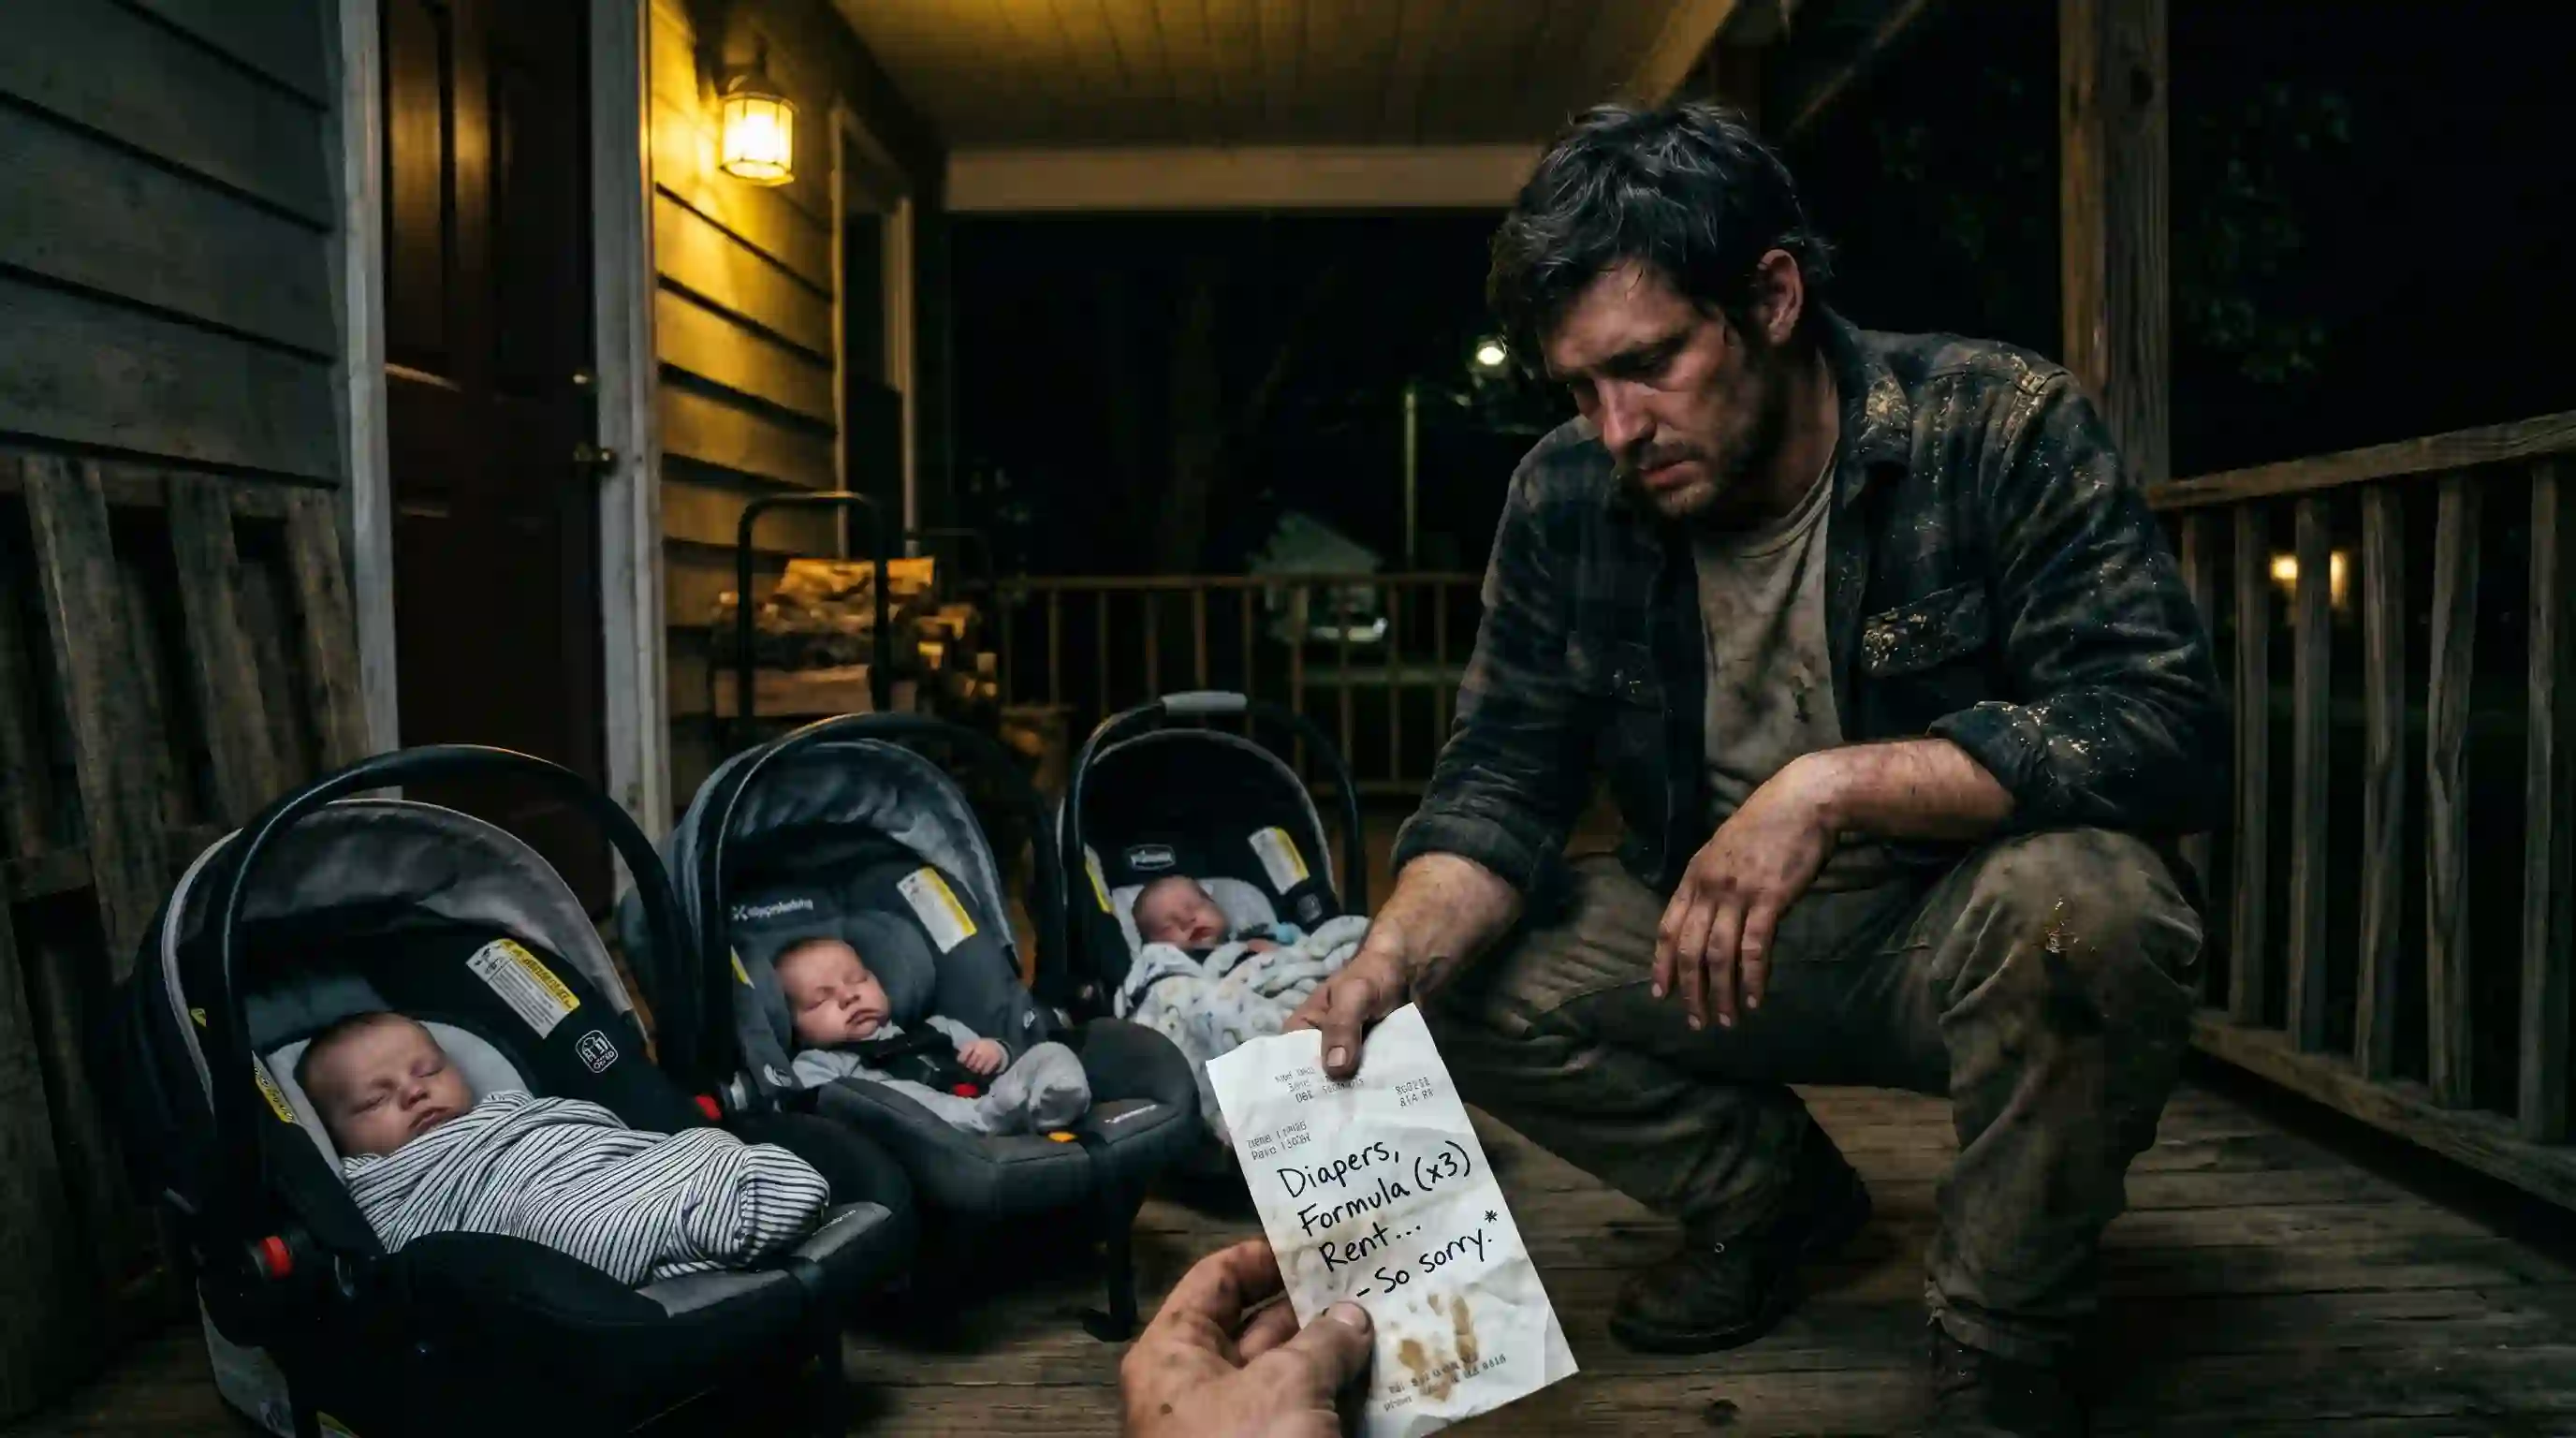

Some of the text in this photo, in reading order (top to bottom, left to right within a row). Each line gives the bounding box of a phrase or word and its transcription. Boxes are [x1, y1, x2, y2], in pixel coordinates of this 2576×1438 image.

[1277, 1141, 1399, 1198] Diapers,
[1297, 1140, 1471, 1238] Formula (x3)
[1318, 1225, 1421, 1273] Rent...
[1375, 1266, 1411, 1294] So
